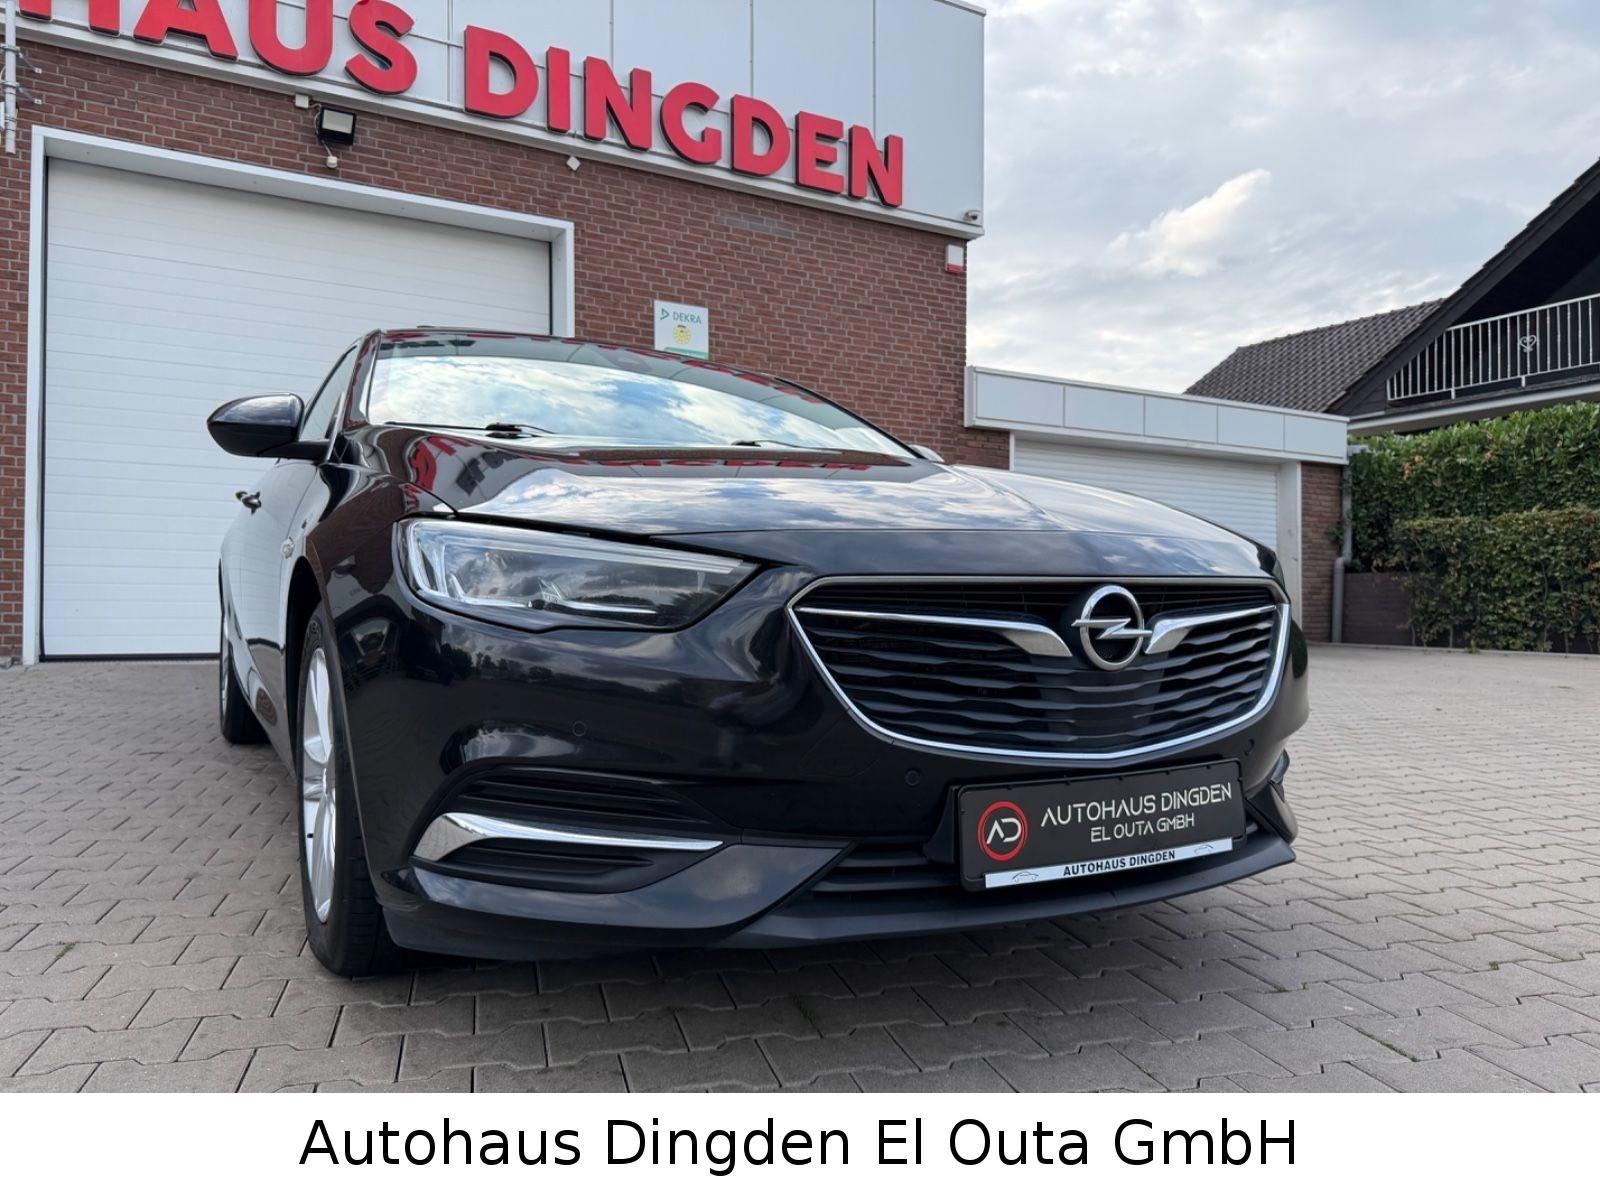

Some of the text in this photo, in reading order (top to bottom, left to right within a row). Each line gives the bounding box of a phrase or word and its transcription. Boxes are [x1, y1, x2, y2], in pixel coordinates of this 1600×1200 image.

[464, 24, 905, 208] DINGDEN
[673, 311, 702, 325] DEKRA
[1040, 782, 1233, 828] AUTOHAUS DINGDEN
[1090, 825, 1111, 844] EL
[1113, 820, 1155, 840] OUTA
[1063, 850, 1176, 876] AUTOHAUS DINGDEN
